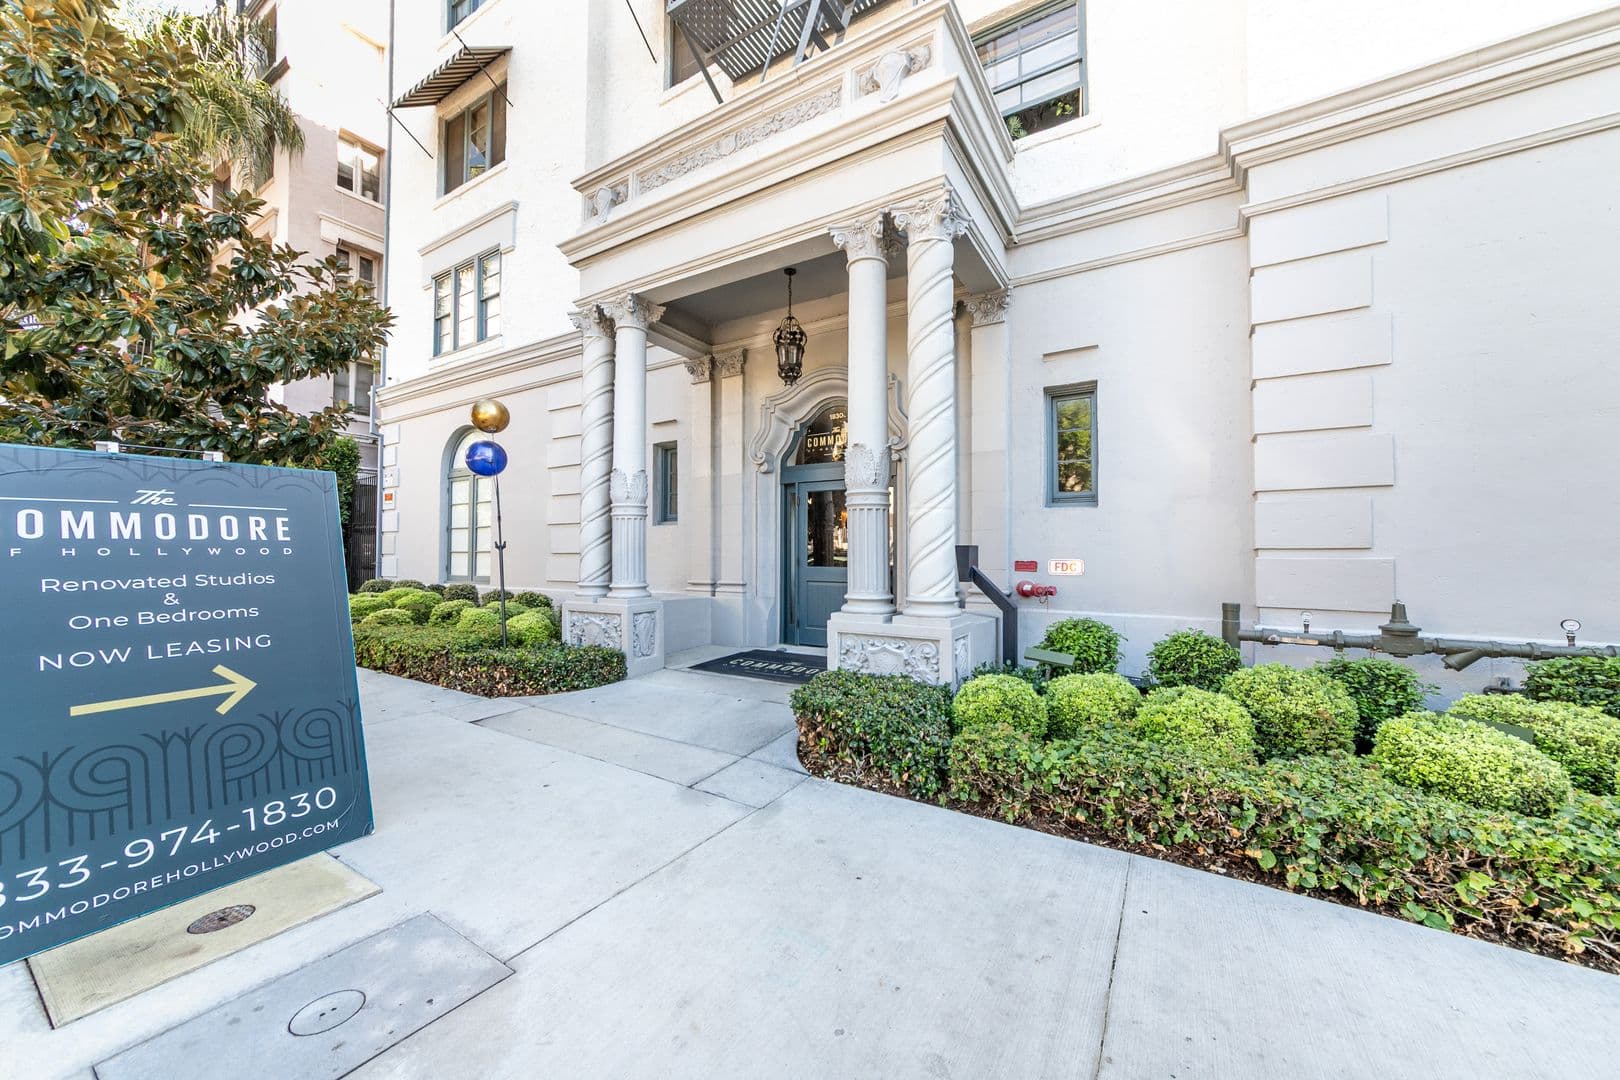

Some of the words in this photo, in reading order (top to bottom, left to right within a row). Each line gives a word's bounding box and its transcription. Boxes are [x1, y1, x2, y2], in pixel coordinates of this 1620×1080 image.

[807, 434, 842, 448] COMMO
[130, 489, 178, 506] The
[15, 508, 291, 542] OMMODORE
[10, 547, 22, 557] F
[61, 547, 293, 557] HOLLYWOOD
[1054, 562, 1077, 572] FDC
[41, 574, 187, 593] Renovated
[194, 572, 276, 588] Studios
[163, 592, 180, 606] &
[68, 615, 129, 630] One
[137, 608, 260, 626] Bedrooms
[39, 646, 132, 672] NOW
[147, 633, 272, 660] LEASING
[729, 659, 820, 674] COMMODO
[0, 786, 337, 908] 33-974-1830
[0, 818, 340, 940] OMMODOREHOLLYWOOD.COM
